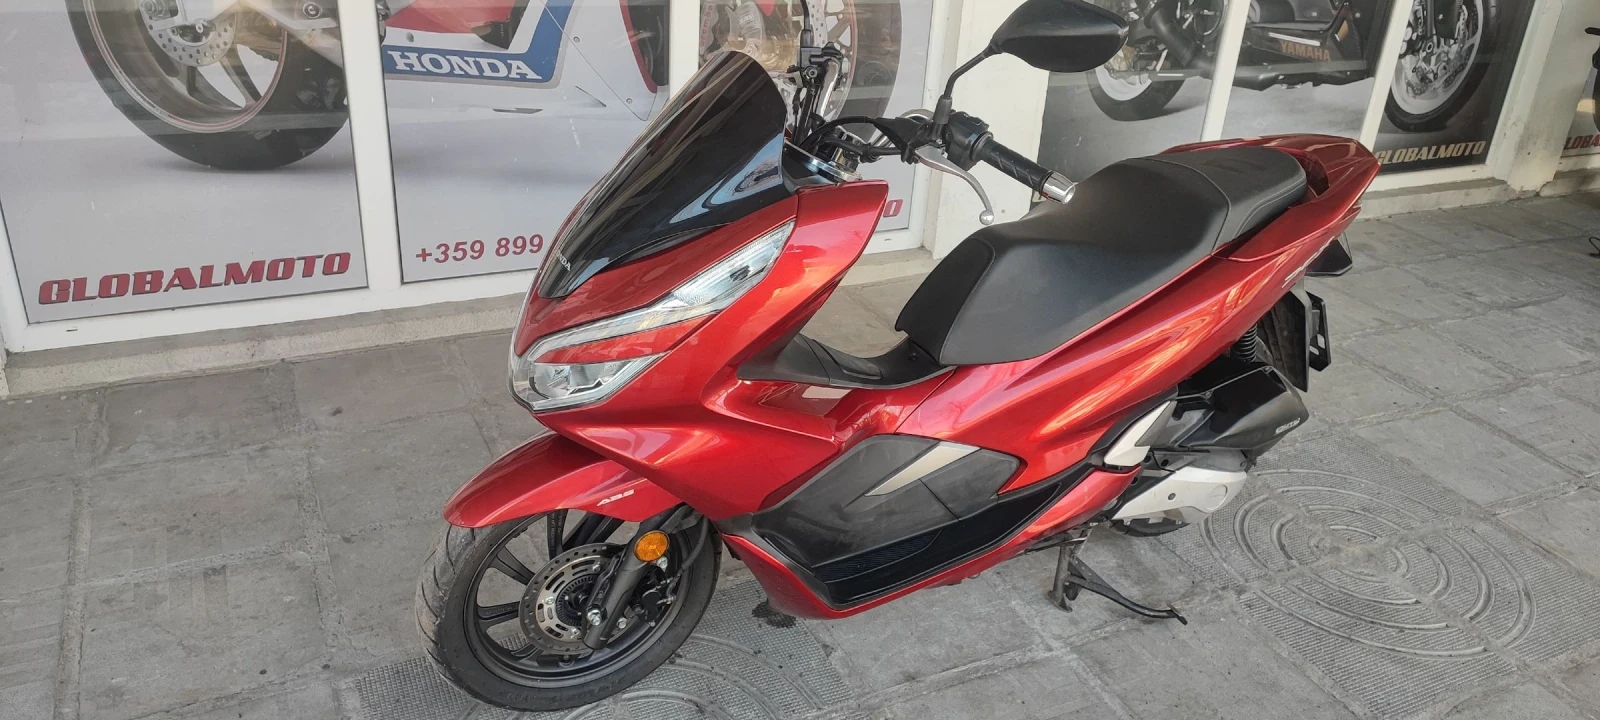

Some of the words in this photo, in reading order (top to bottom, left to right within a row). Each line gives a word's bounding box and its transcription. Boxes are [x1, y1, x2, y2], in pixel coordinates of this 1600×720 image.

[387, 50, 543, 80] HONDA
[1280, 40, 1331, 62] YAMAHA
[1375, 141, 1486, 165] GLOBALMOTO
[416, 239, 485, 264] +359
[495, 233, 544, 258] 899
[38, 252, 351, 305] GLOBALMOTO
